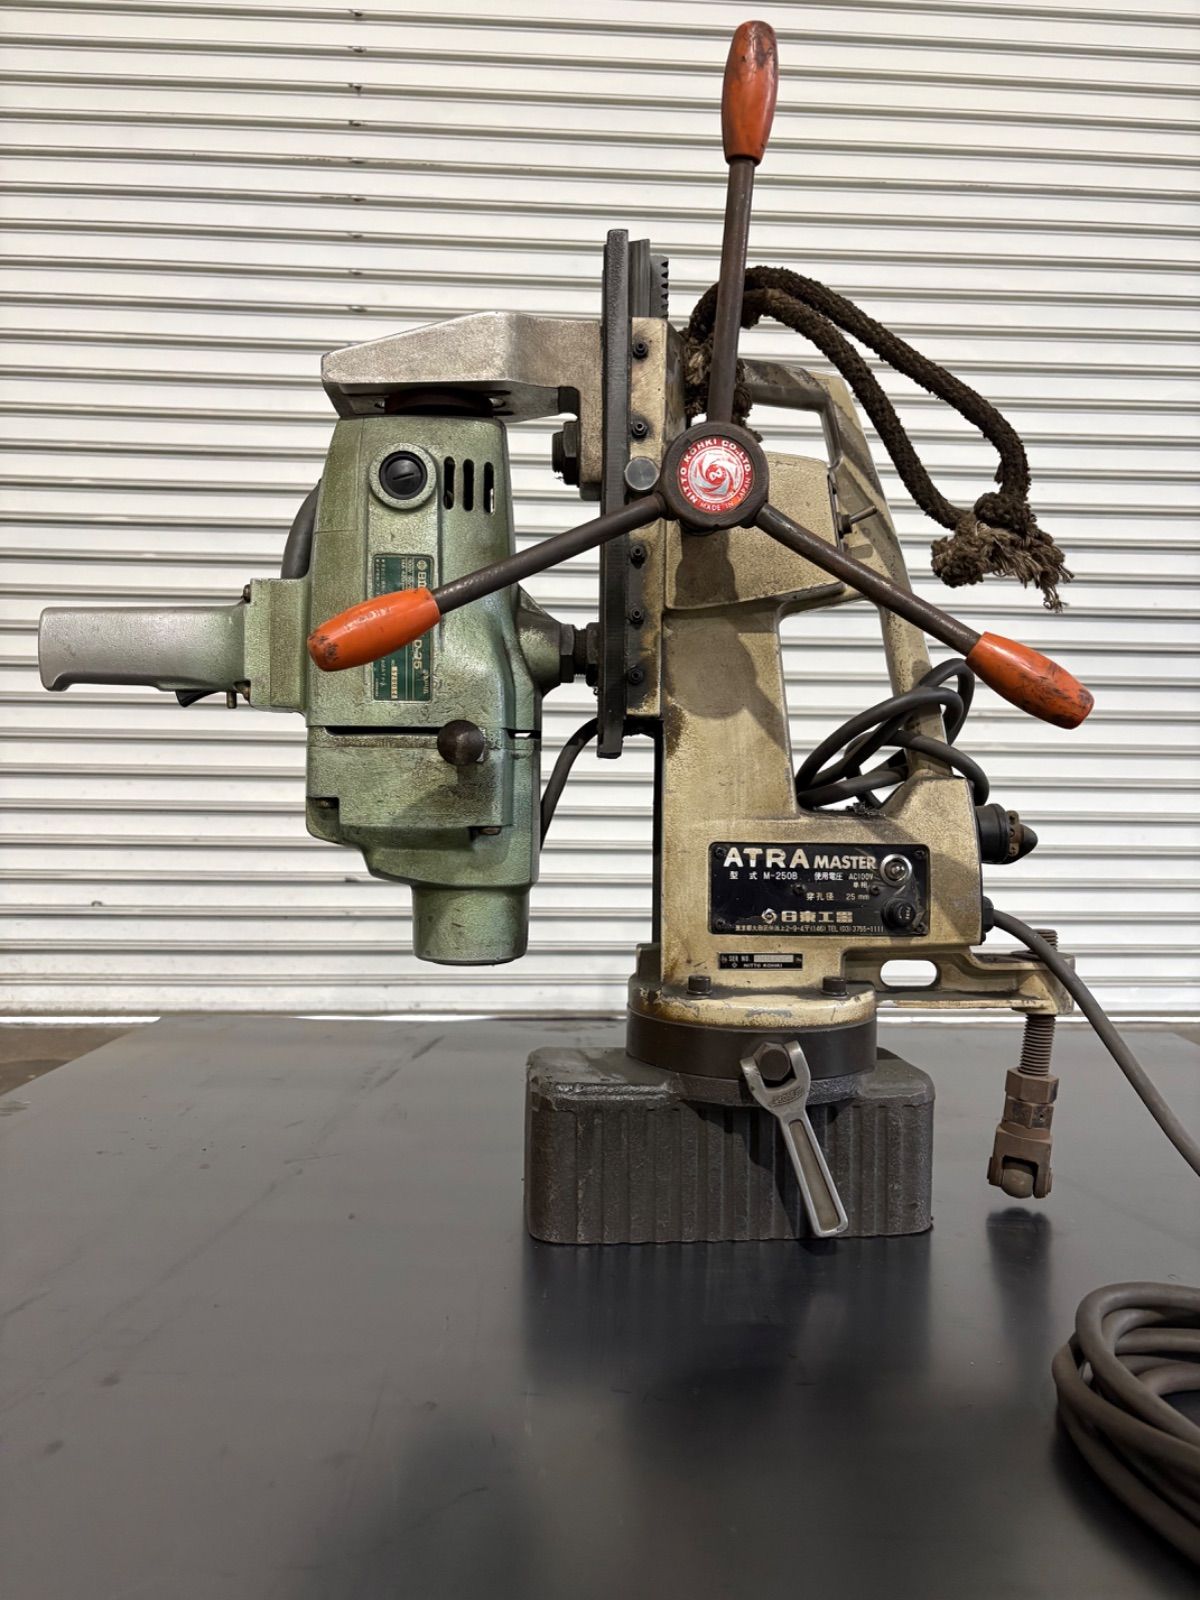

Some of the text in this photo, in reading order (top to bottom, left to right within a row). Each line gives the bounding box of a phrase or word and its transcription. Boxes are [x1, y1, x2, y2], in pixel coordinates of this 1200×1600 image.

[680, 467, 698, 504] NITTO
[700, 478, 752, 511] MADE IN JAPAN
[723, 847, 877, 870] ATRA MASTER
[763, 872, 798, 881] M-250B
[814, 871, 844, 881] 使用電圧
[848, 872, 874, 881] AC100V
[845, 893, 856, 901] 25
[781, 910, 853, 924] 日東工器
[828, 925, 839, 933] TEL
